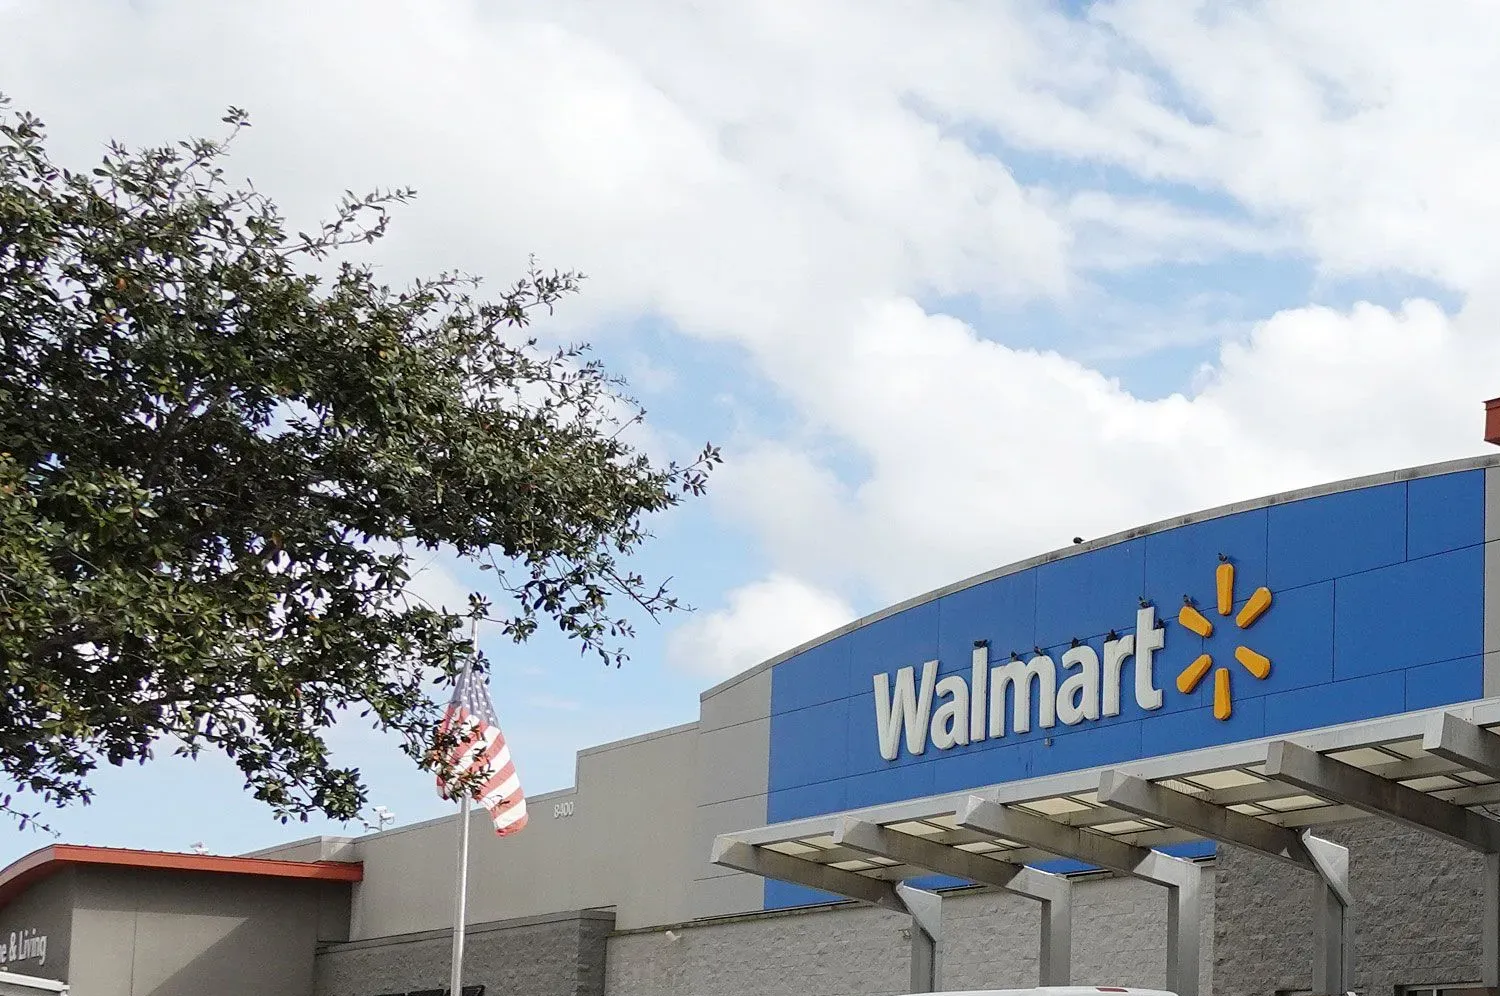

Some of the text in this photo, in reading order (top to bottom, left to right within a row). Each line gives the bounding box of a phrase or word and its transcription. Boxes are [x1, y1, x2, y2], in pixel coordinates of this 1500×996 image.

[873, 606, 1165, 761] Walmart
[9, 932, 17, 961] &
[18, 928, 48, 966] Living
